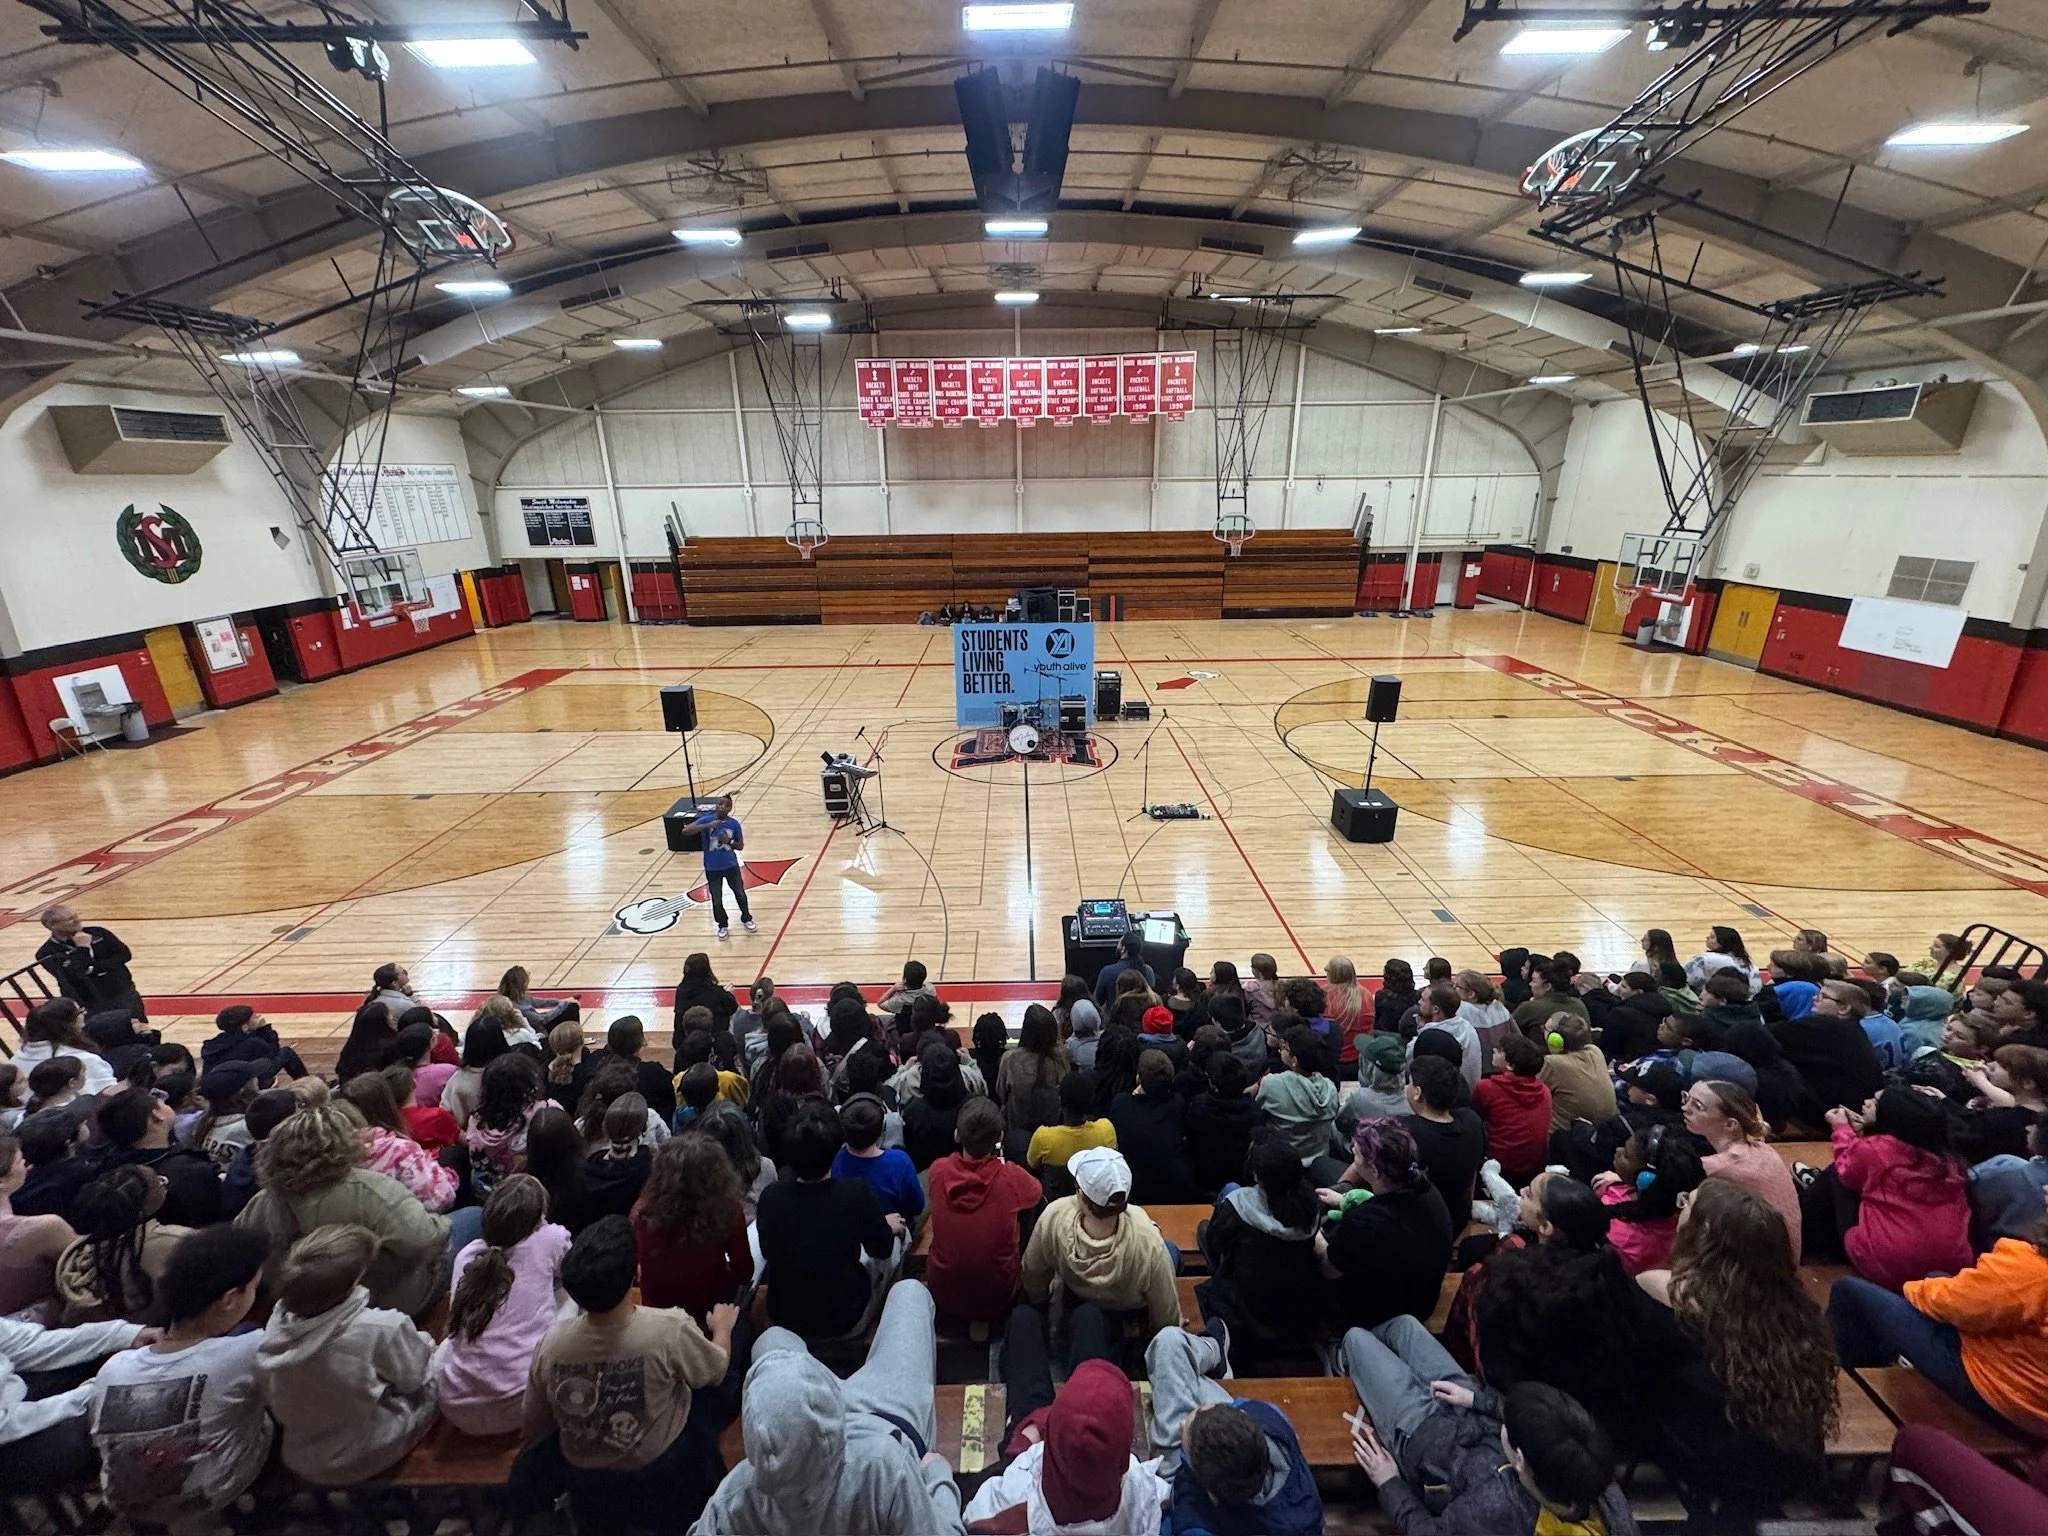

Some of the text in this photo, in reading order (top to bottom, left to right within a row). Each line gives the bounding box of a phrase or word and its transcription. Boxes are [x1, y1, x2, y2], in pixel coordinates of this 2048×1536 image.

[961, 629, 1028, 651] STUDENTS
[962, 651, 1004, 672] LIVING
[1033, 662, 1061, 673] youth
[963, 673, 1015, 694] BETTER.
